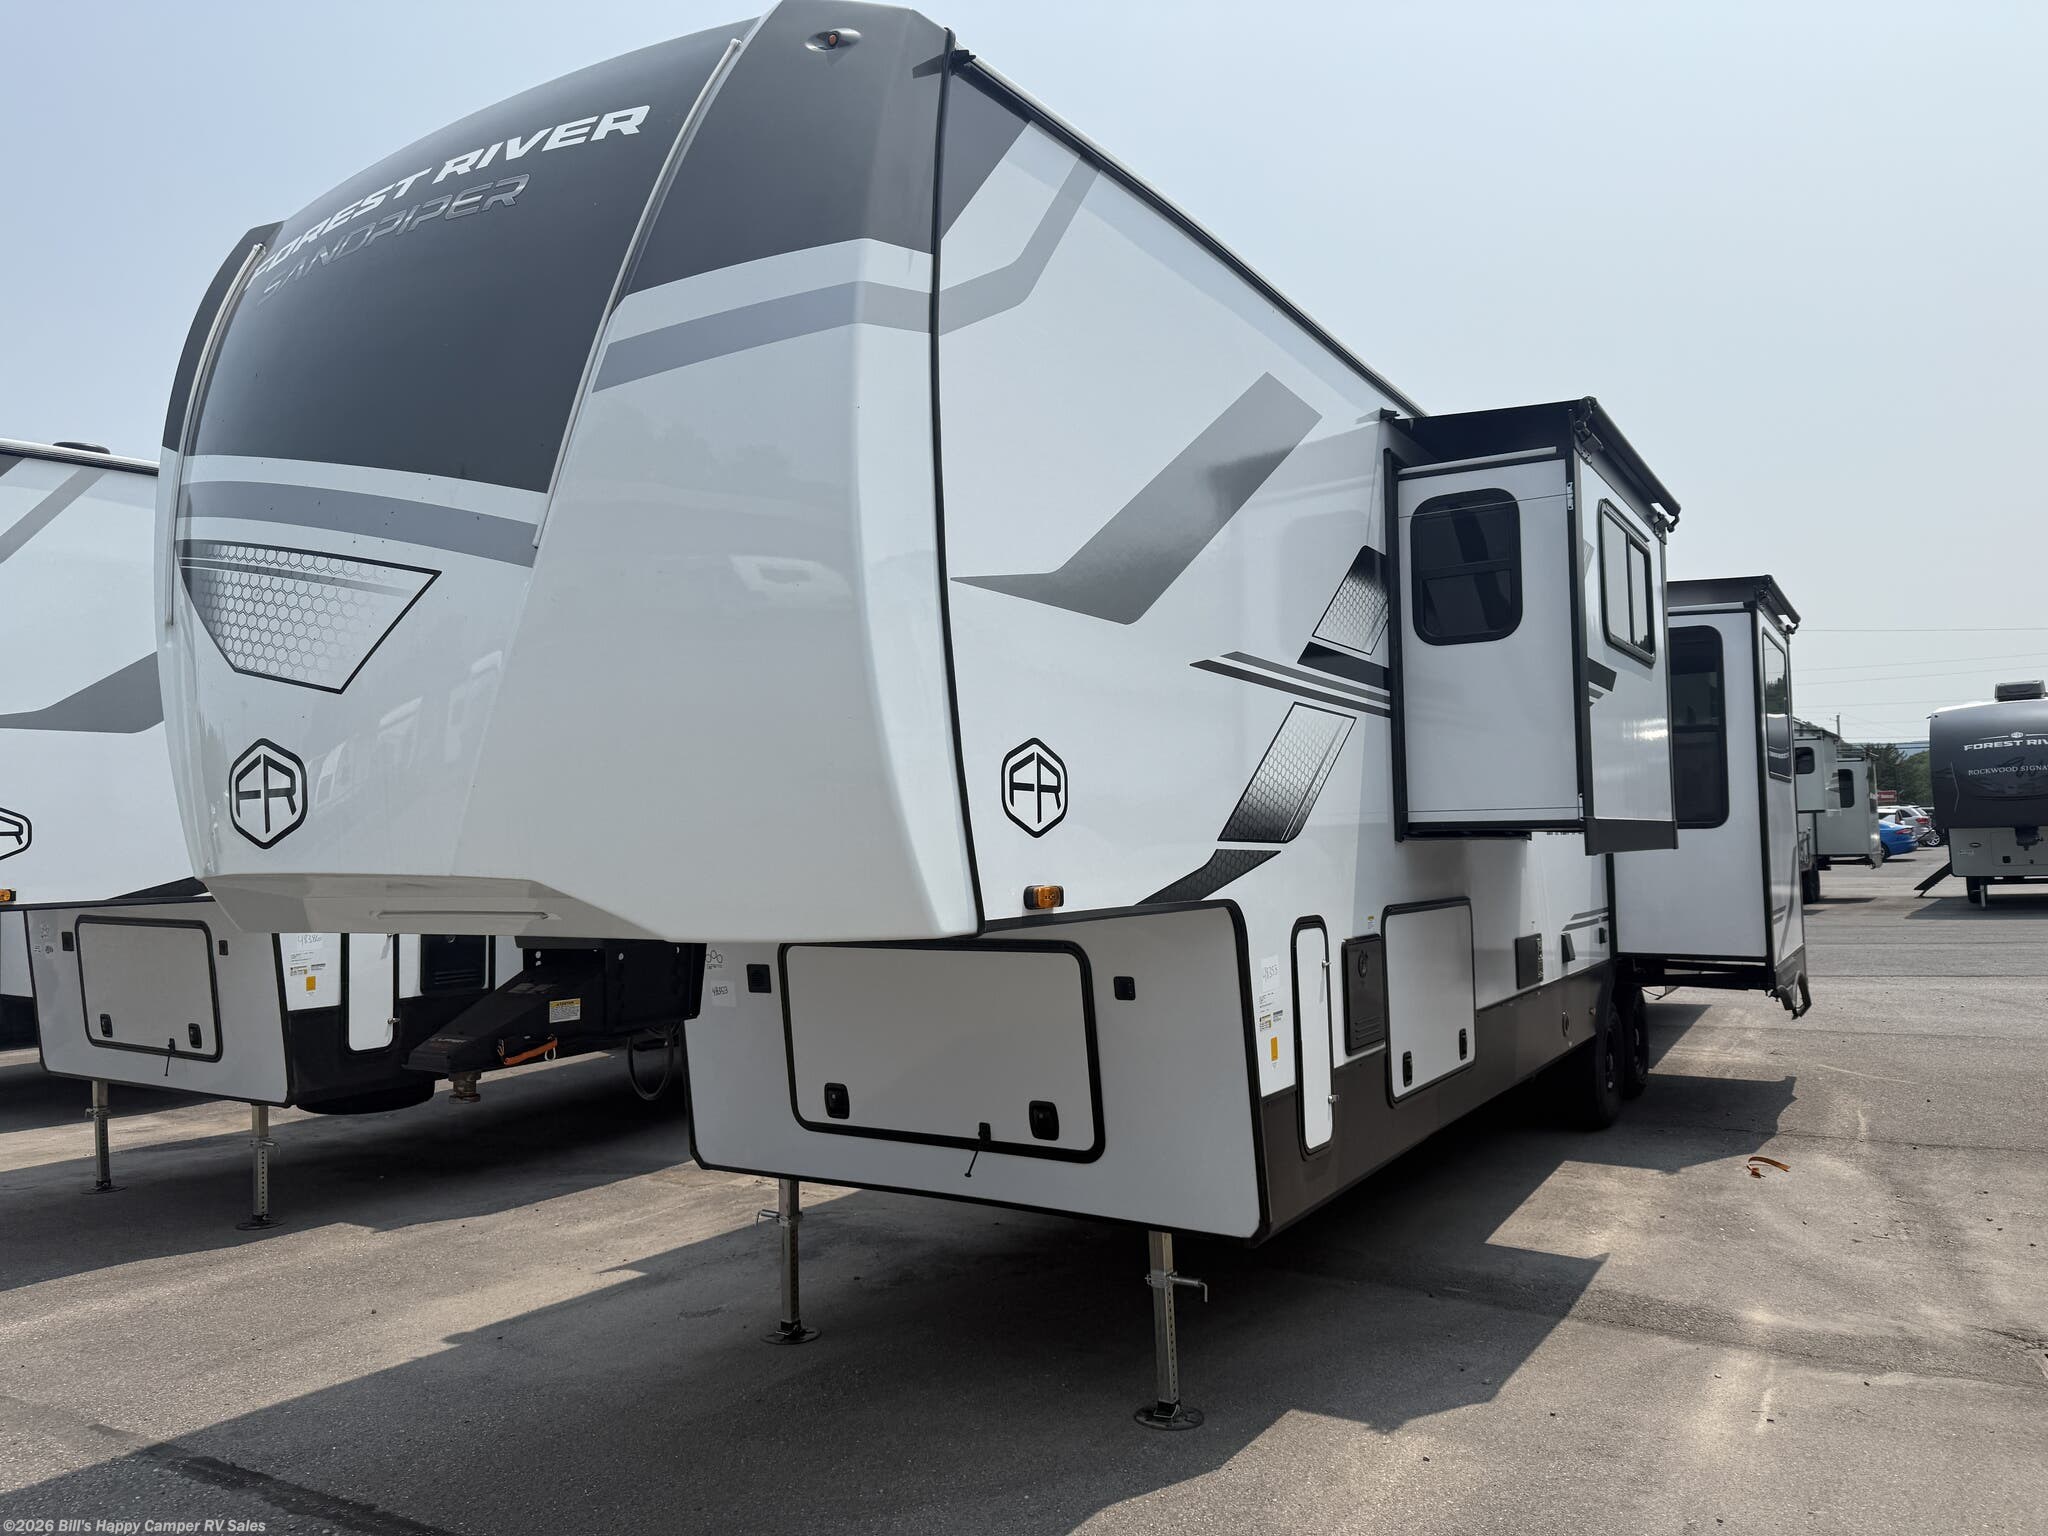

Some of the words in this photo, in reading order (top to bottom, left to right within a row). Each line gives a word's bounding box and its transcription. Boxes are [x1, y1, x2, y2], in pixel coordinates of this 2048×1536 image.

[243, 167, 433, 292] FOREST
[432, 105, 651, 185] RIVER
[257, 173, 530, 306] SANDPIPER
[1963, 740, 2024, 751] FOREST
[1968, 766, 2018, 776] ROCKWOOD
